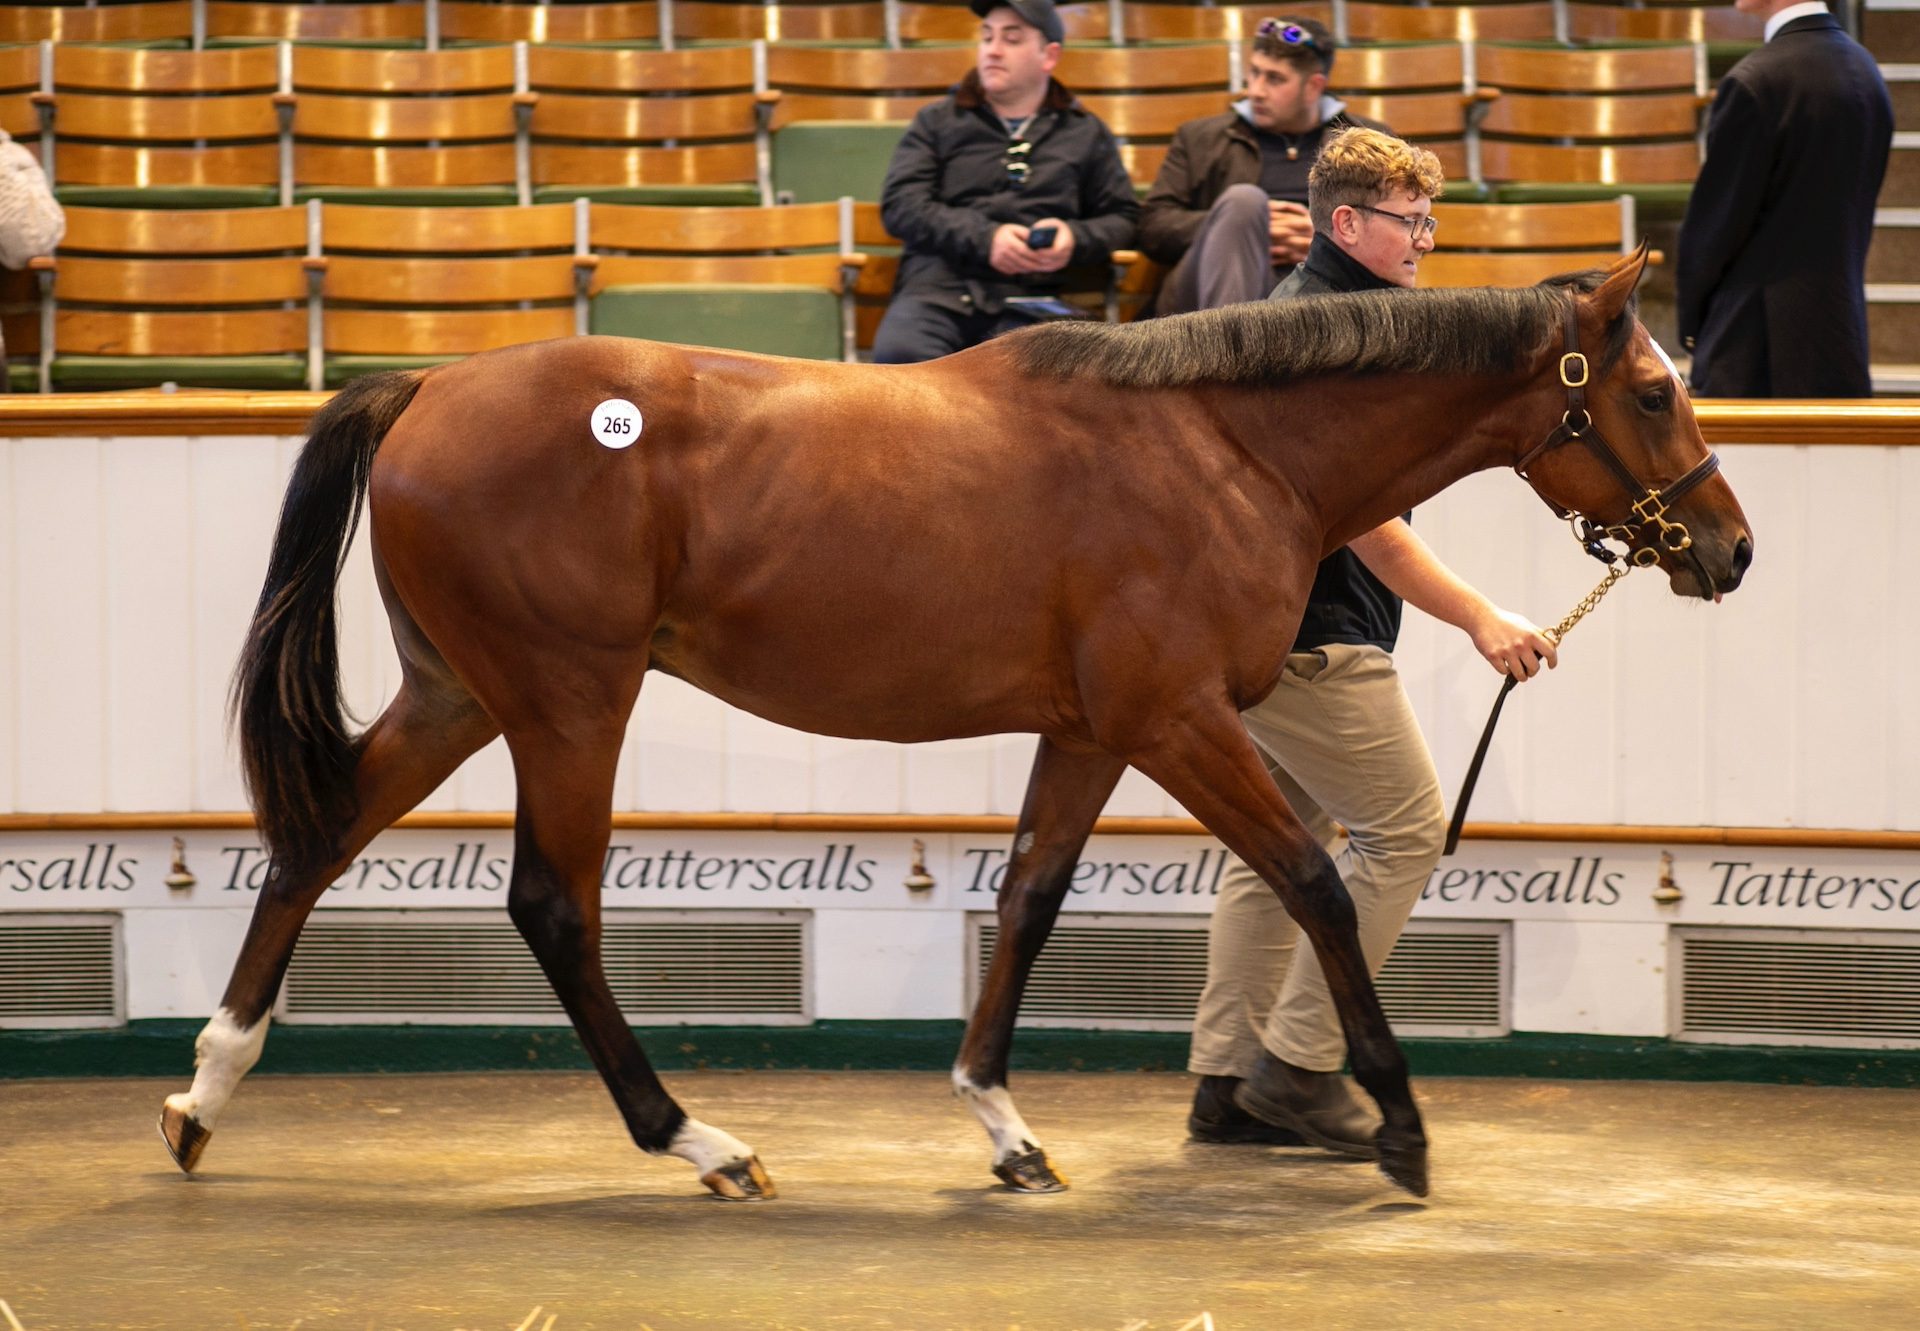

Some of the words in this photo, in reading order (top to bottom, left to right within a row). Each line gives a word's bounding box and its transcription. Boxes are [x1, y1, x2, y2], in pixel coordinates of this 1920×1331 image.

[603, 416, 631, 434] 265
[221, 843, 507, 891] Trsalls
[600, 844, 877, 892] Tattersalls
[964, 848, 1228, 895] Tersall
[1421, 856, 1624, 905] tersalls
